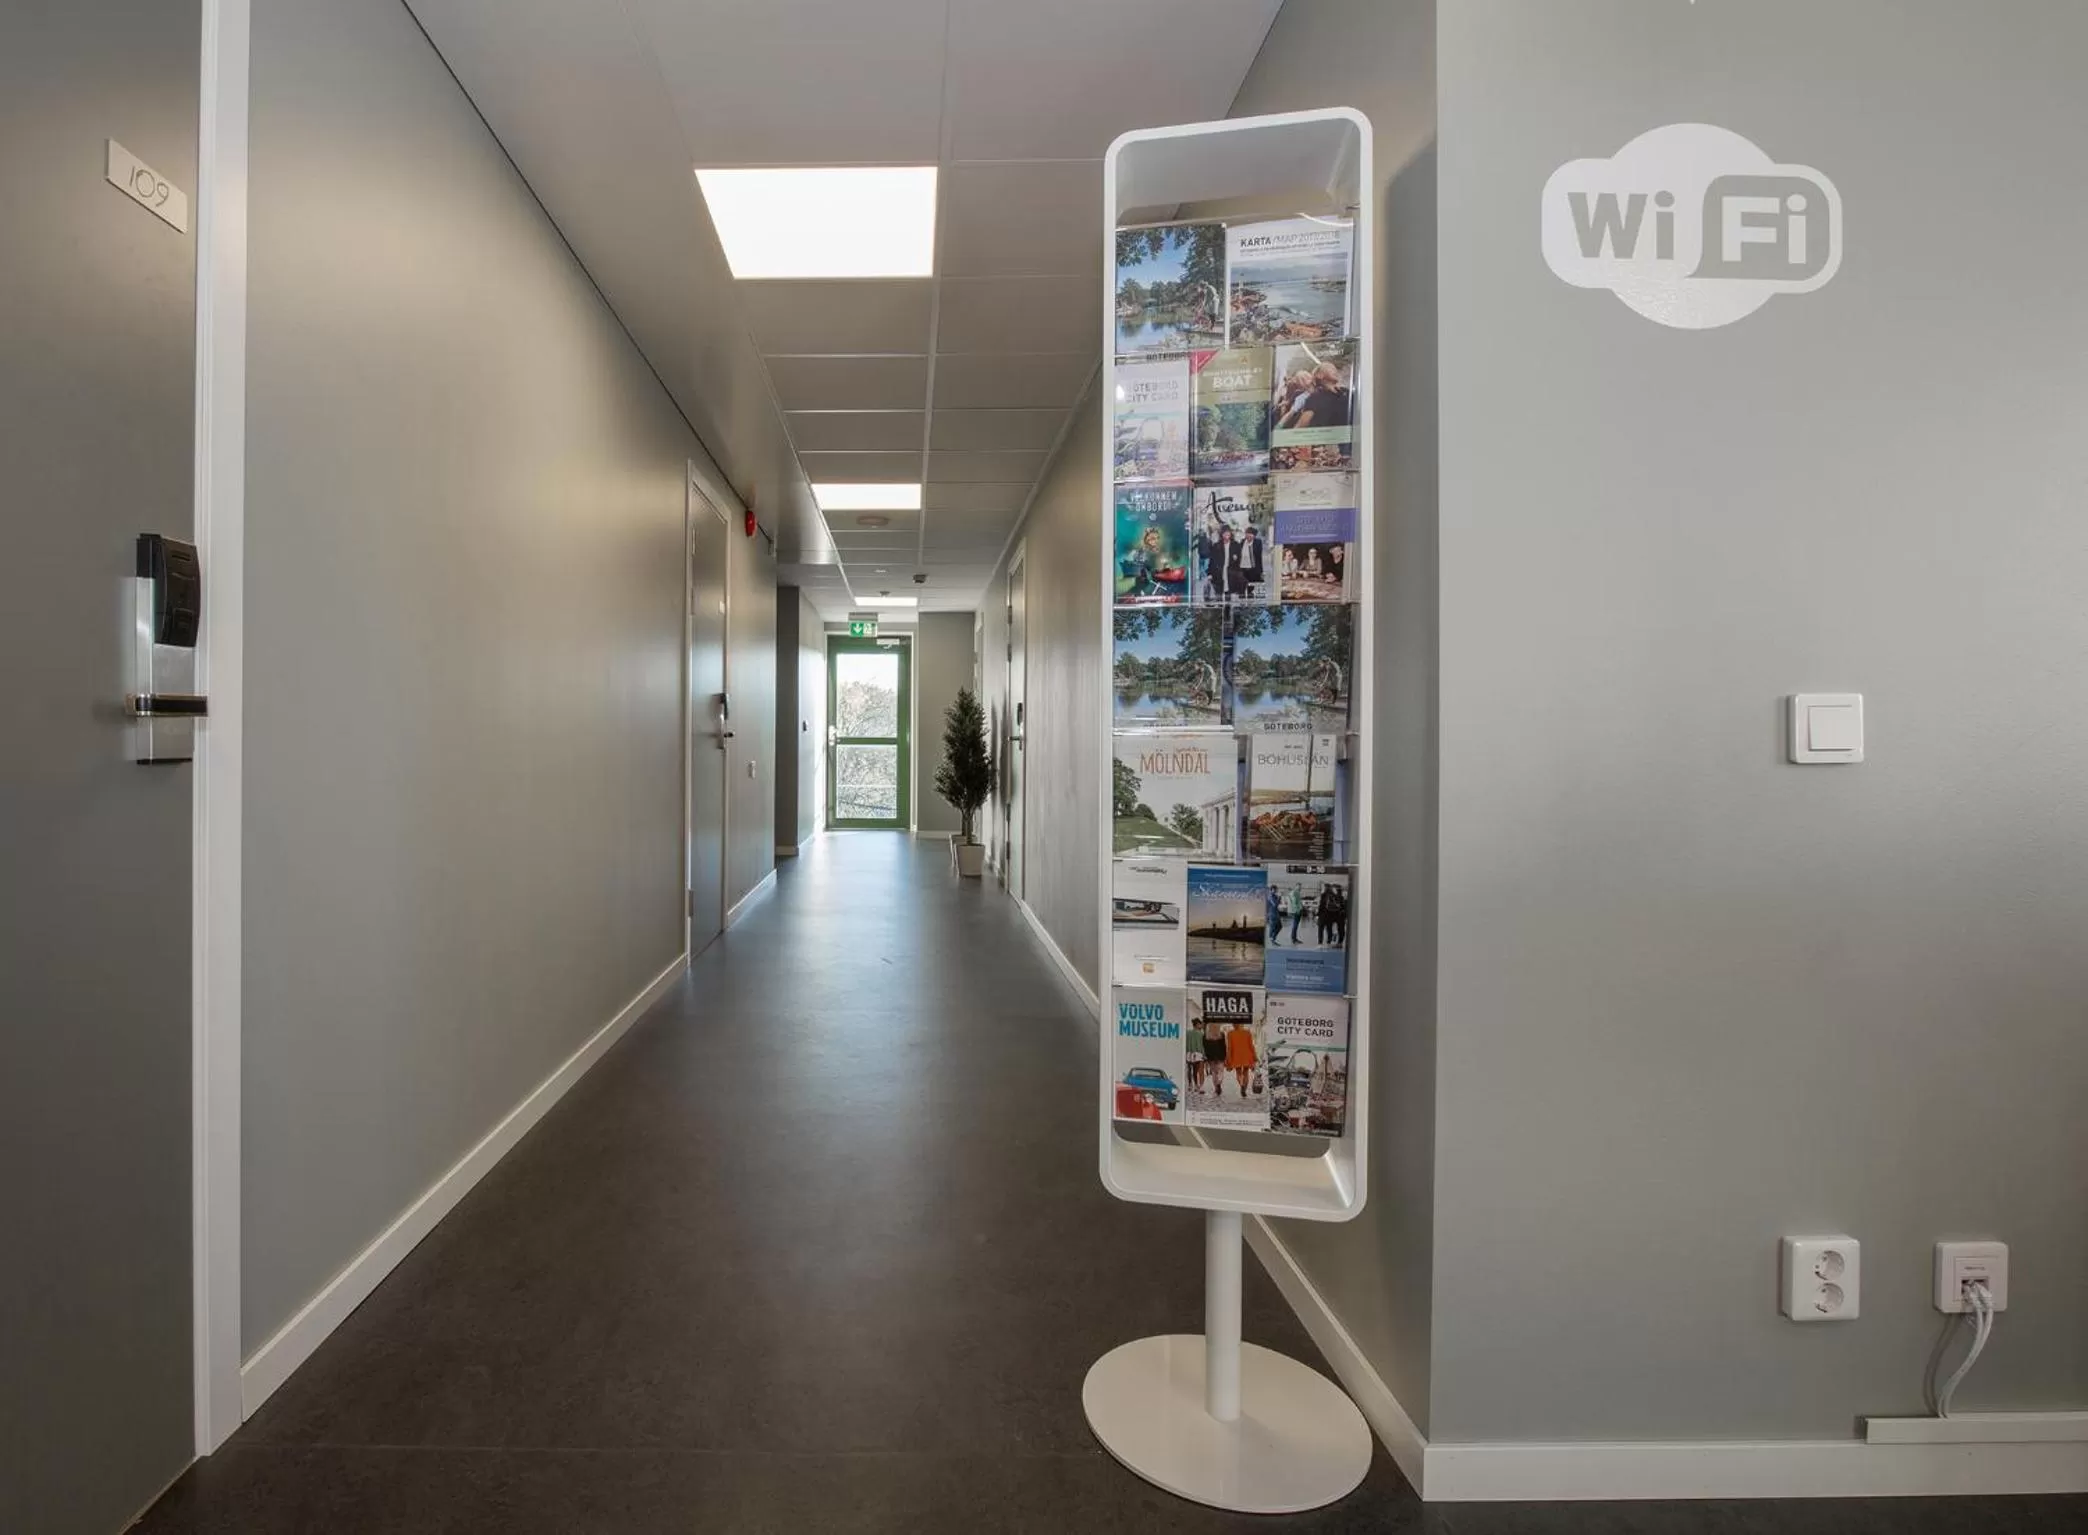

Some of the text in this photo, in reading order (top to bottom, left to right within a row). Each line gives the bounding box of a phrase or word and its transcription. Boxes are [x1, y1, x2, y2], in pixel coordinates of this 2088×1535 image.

[129, 166, 169, 207] 109
[1213, 374, 1253, 389] BOAT
[1119, 1003, 1164, 1020] VOLVO
[1206, 997, 1249, 1013] HAGA
[1119, 1020, 1180, 1039] MUSEUM
[1277, 1025, 1334, 1038] CITY CARD
